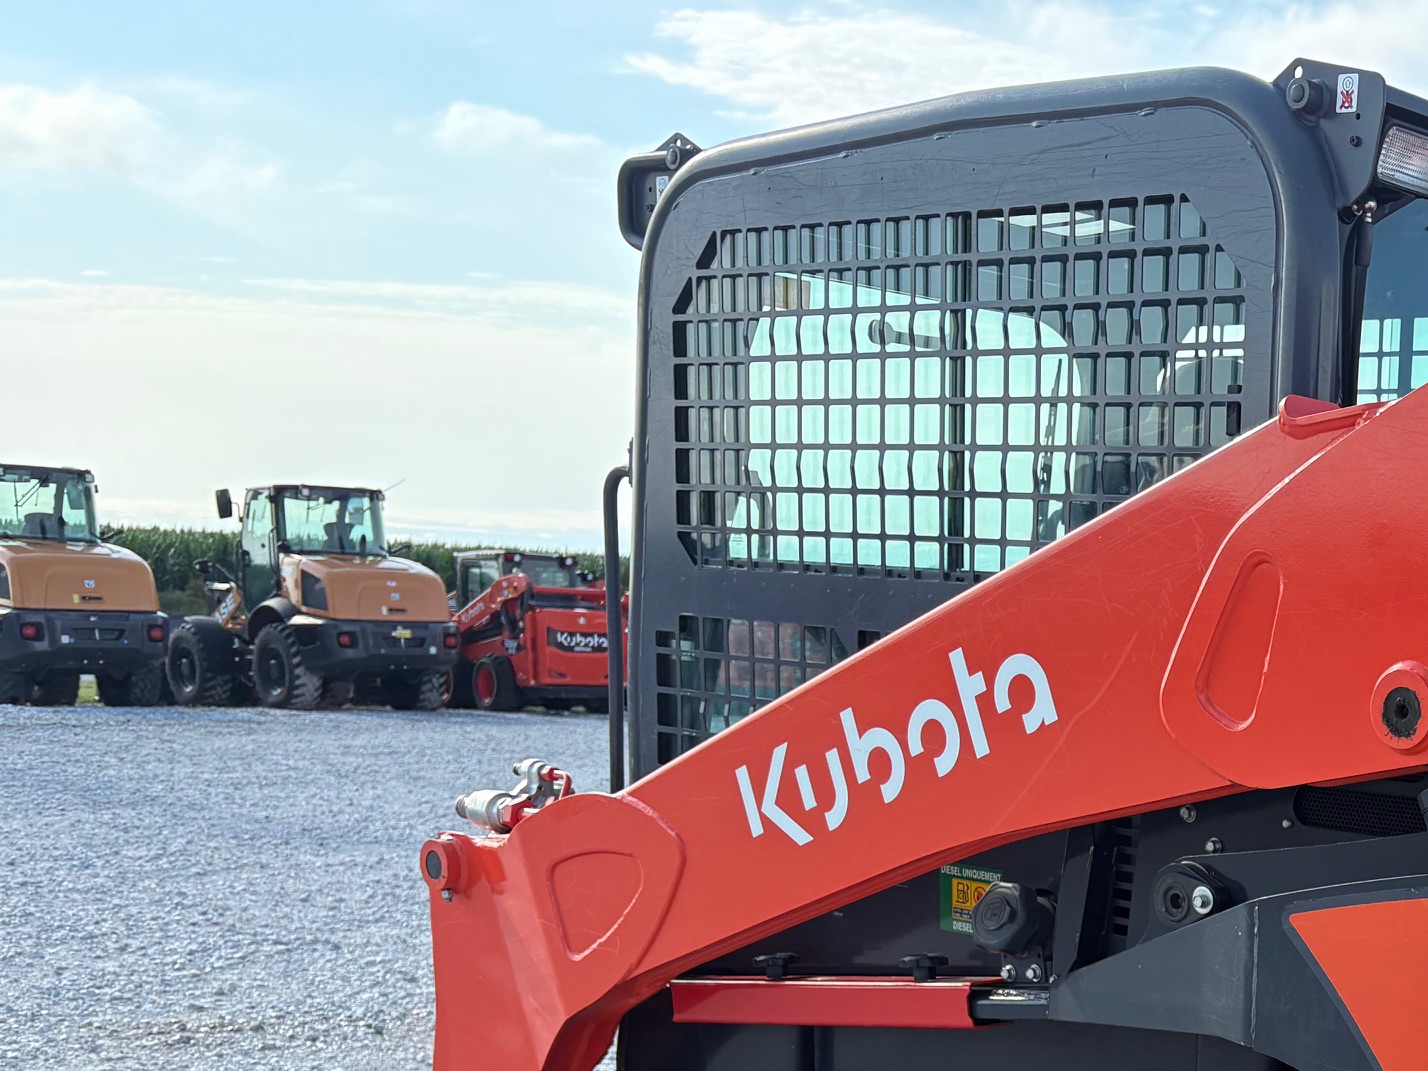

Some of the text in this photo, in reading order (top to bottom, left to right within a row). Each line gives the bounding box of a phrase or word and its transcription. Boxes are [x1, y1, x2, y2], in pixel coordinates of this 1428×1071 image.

[735, 647, 1058, 846] Kubota
[941, 866, 1002, 882] DIESEL UNIQUEMENT
[952, 921, 974, 933] DIESEL
